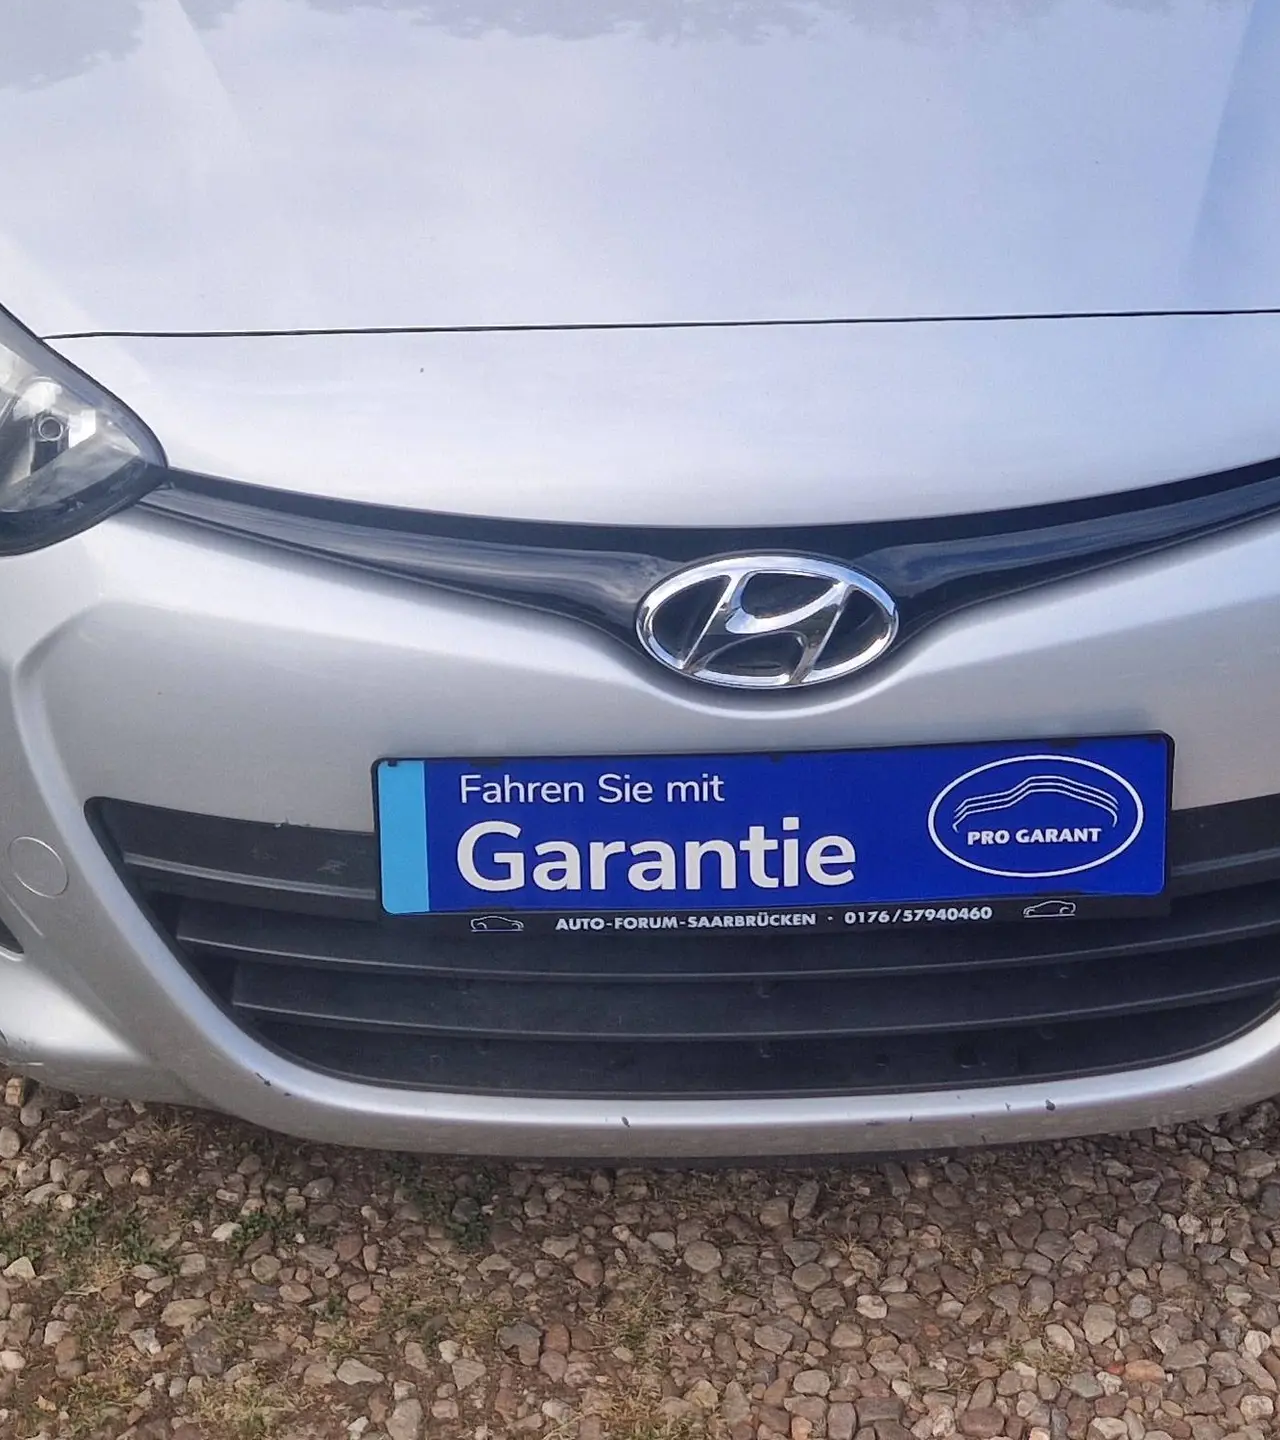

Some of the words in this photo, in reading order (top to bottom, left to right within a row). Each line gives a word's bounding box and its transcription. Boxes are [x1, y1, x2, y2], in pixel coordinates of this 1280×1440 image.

[460, 773, 585, 804] Fahren
[597, 773, 654, 803] Sie
[666, 773, 725, 803] mit
[967, 829, 1010, 846] PRO
[1015, 827, 1102, 844] GARANT
[456, 816, 856, 892] Garantie
[554, 911, 817, 932] AUTO-FORUM-SAARBRÜCKEN
[844, 906, 993, 925] 0176/57940460
